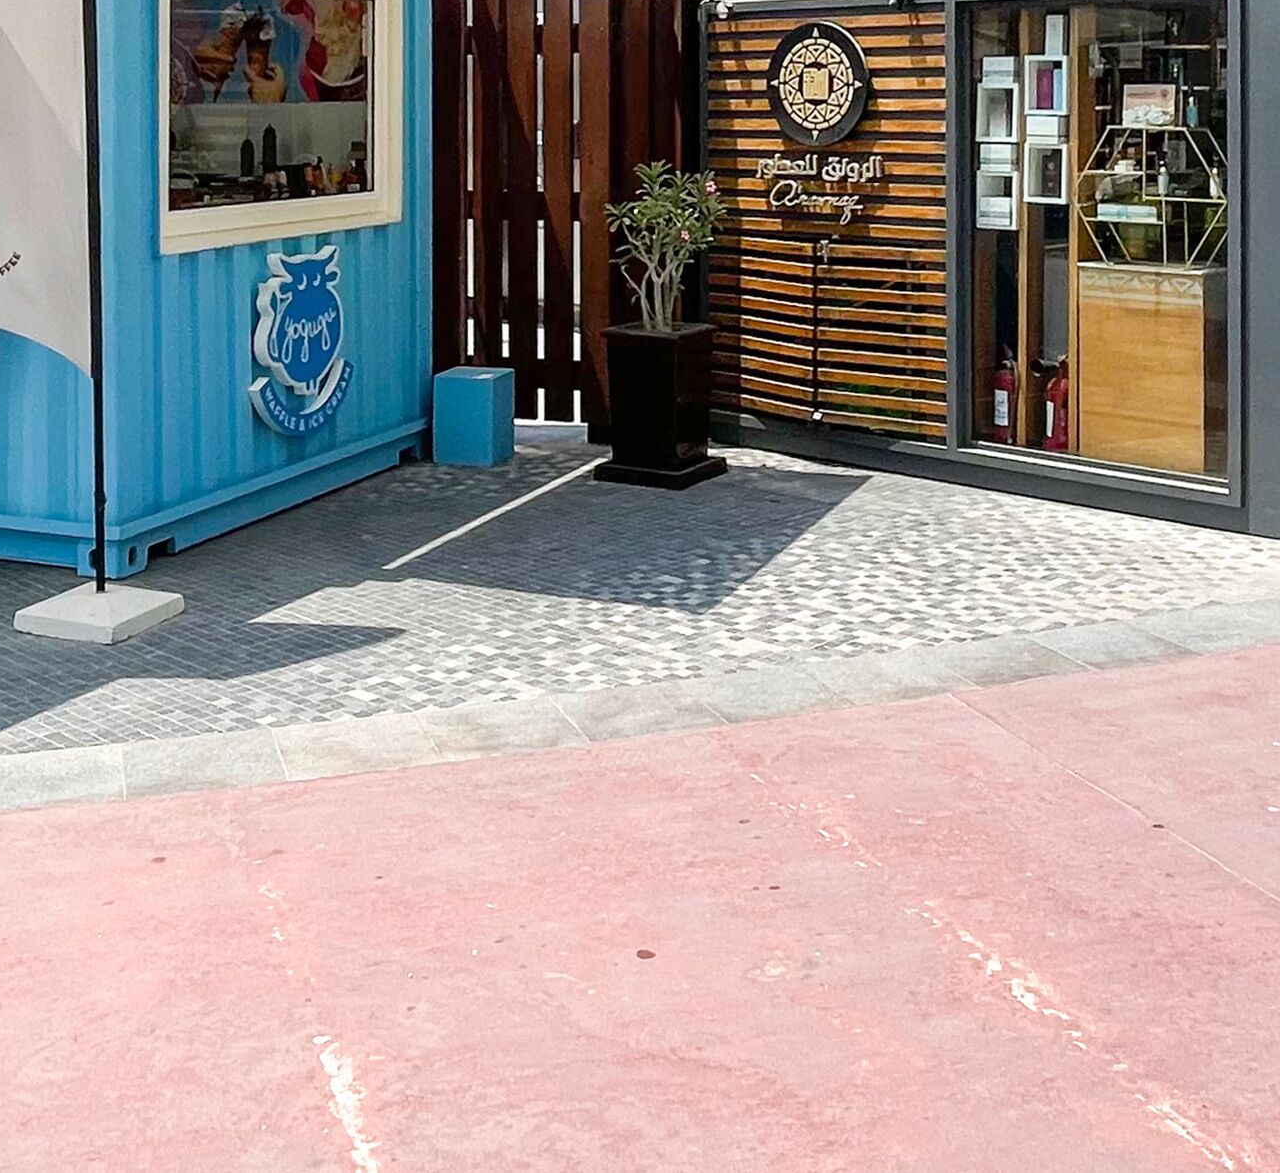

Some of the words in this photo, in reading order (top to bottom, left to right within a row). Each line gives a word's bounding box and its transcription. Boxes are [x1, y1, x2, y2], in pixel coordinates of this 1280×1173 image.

[265, 385, 296, 430] WAFFLE
[298, 418, 306, 432] &
[308, 409, 325, 429] ICE
[326, 366, 352, 415] CREAM
